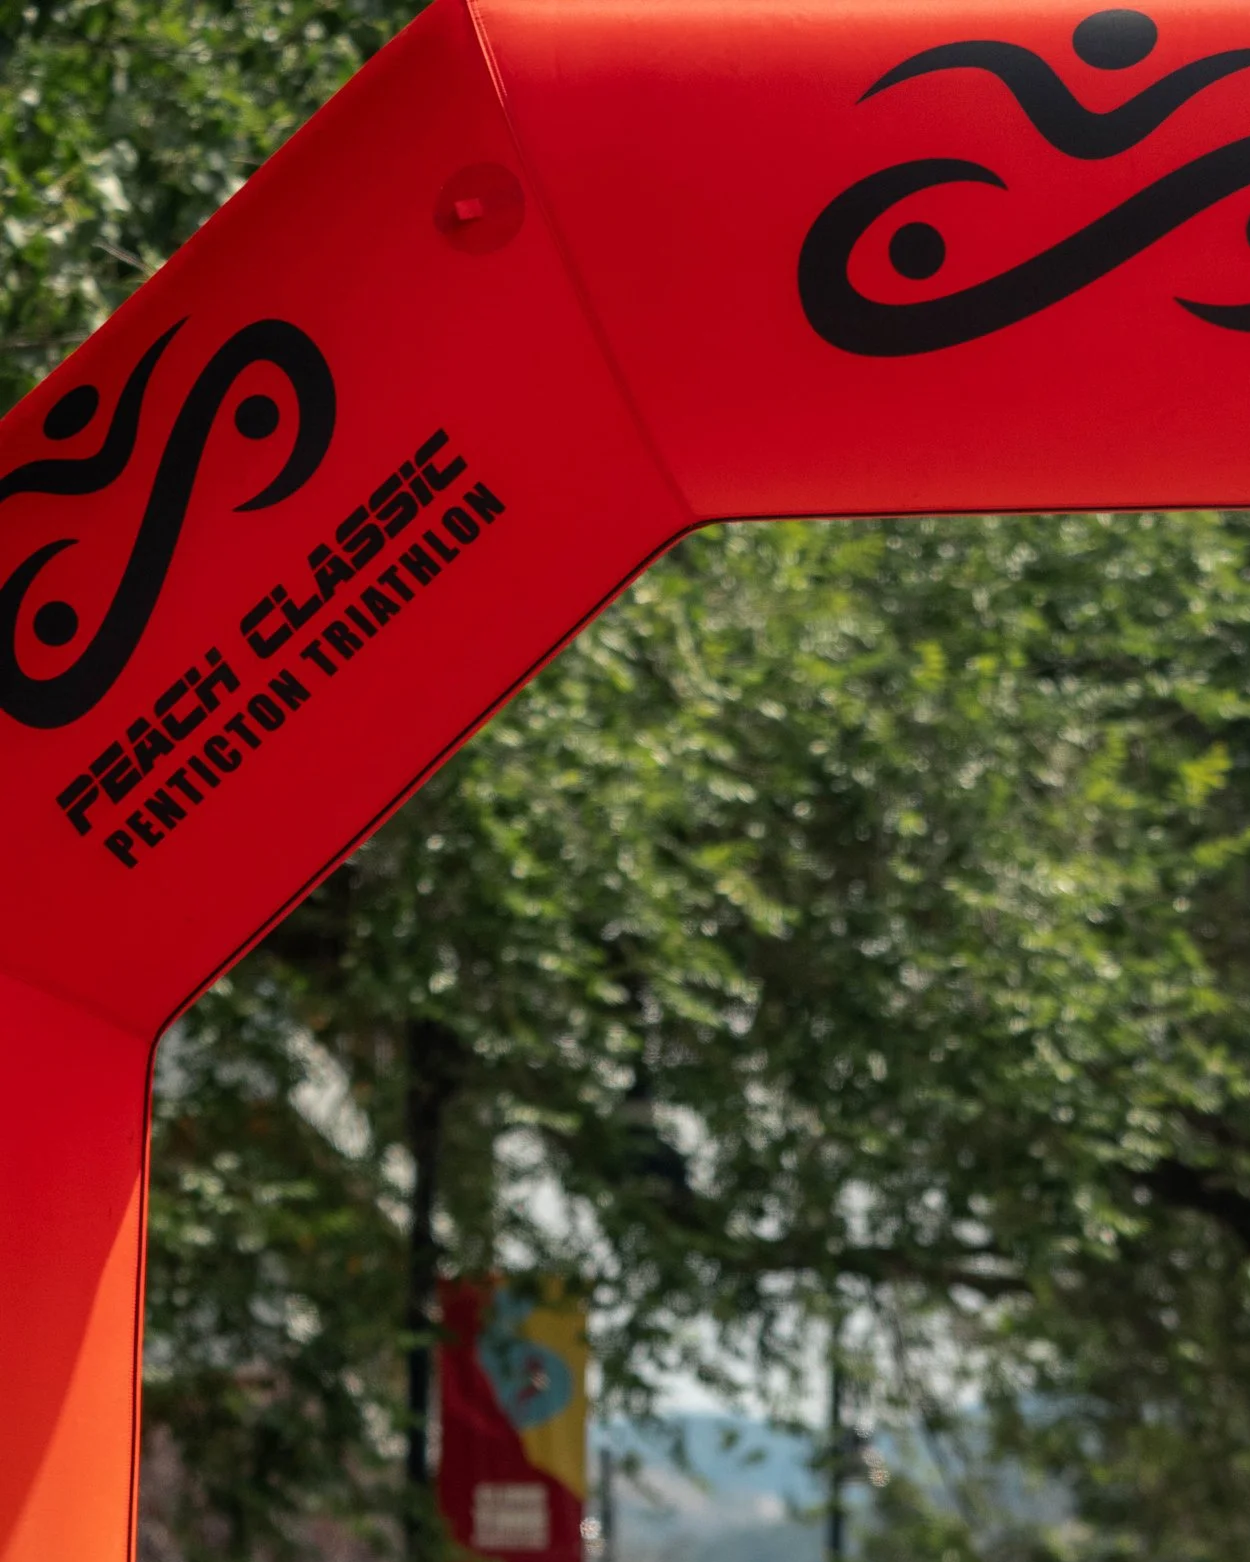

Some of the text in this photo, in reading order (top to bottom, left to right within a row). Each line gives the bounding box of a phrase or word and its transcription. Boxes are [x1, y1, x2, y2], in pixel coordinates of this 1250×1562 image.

[56, 428, 467, 837] PEACH CLASSIC
[104, 482, 505, 869] PENTICTON TRIATHLON
